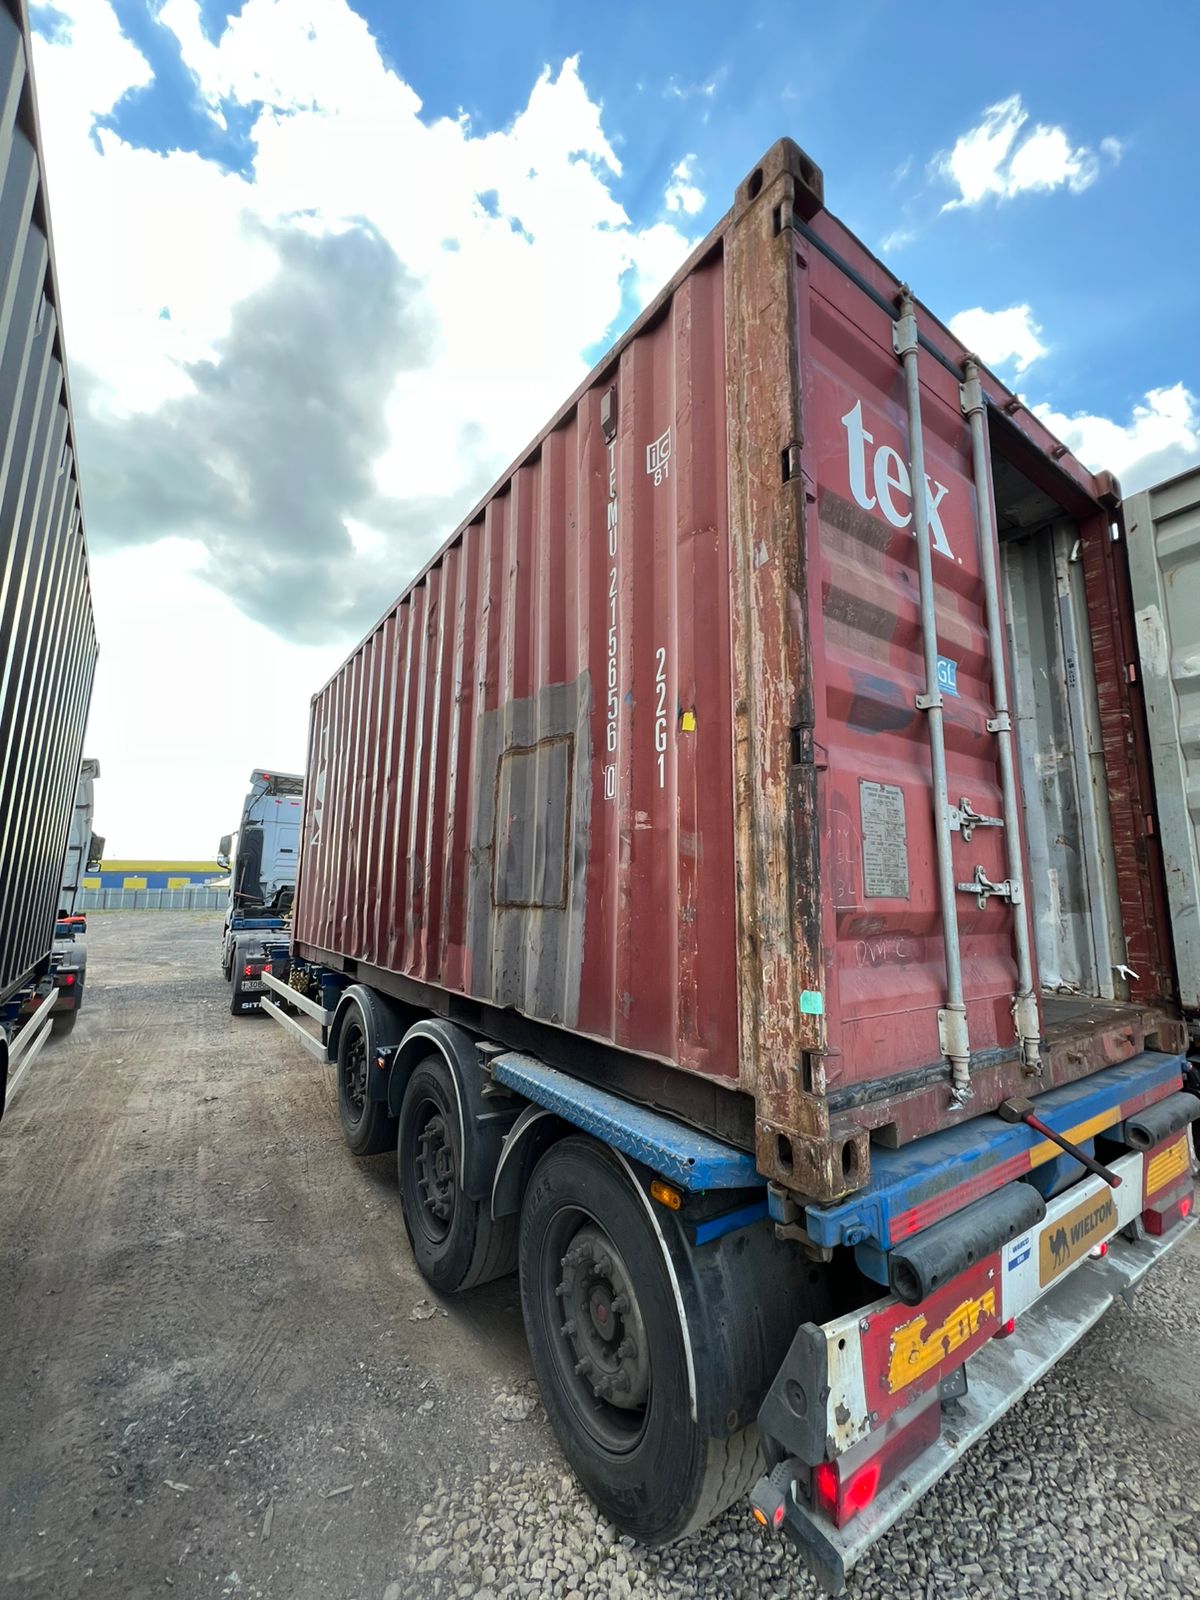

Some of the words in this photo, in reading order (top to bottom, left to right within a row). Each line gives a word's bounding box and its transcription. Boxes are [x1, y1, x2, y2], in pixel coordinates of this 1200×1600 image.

[607, 439, 618, 557] TEMU
[654, 461, 669, 487] 81
[606, 567, 618, 752] 215656
[655, 647, 667, 789] 22G1
[606, 765, 616, 799] 0
[1070, 1199, 1113, 1246] WIELTON
